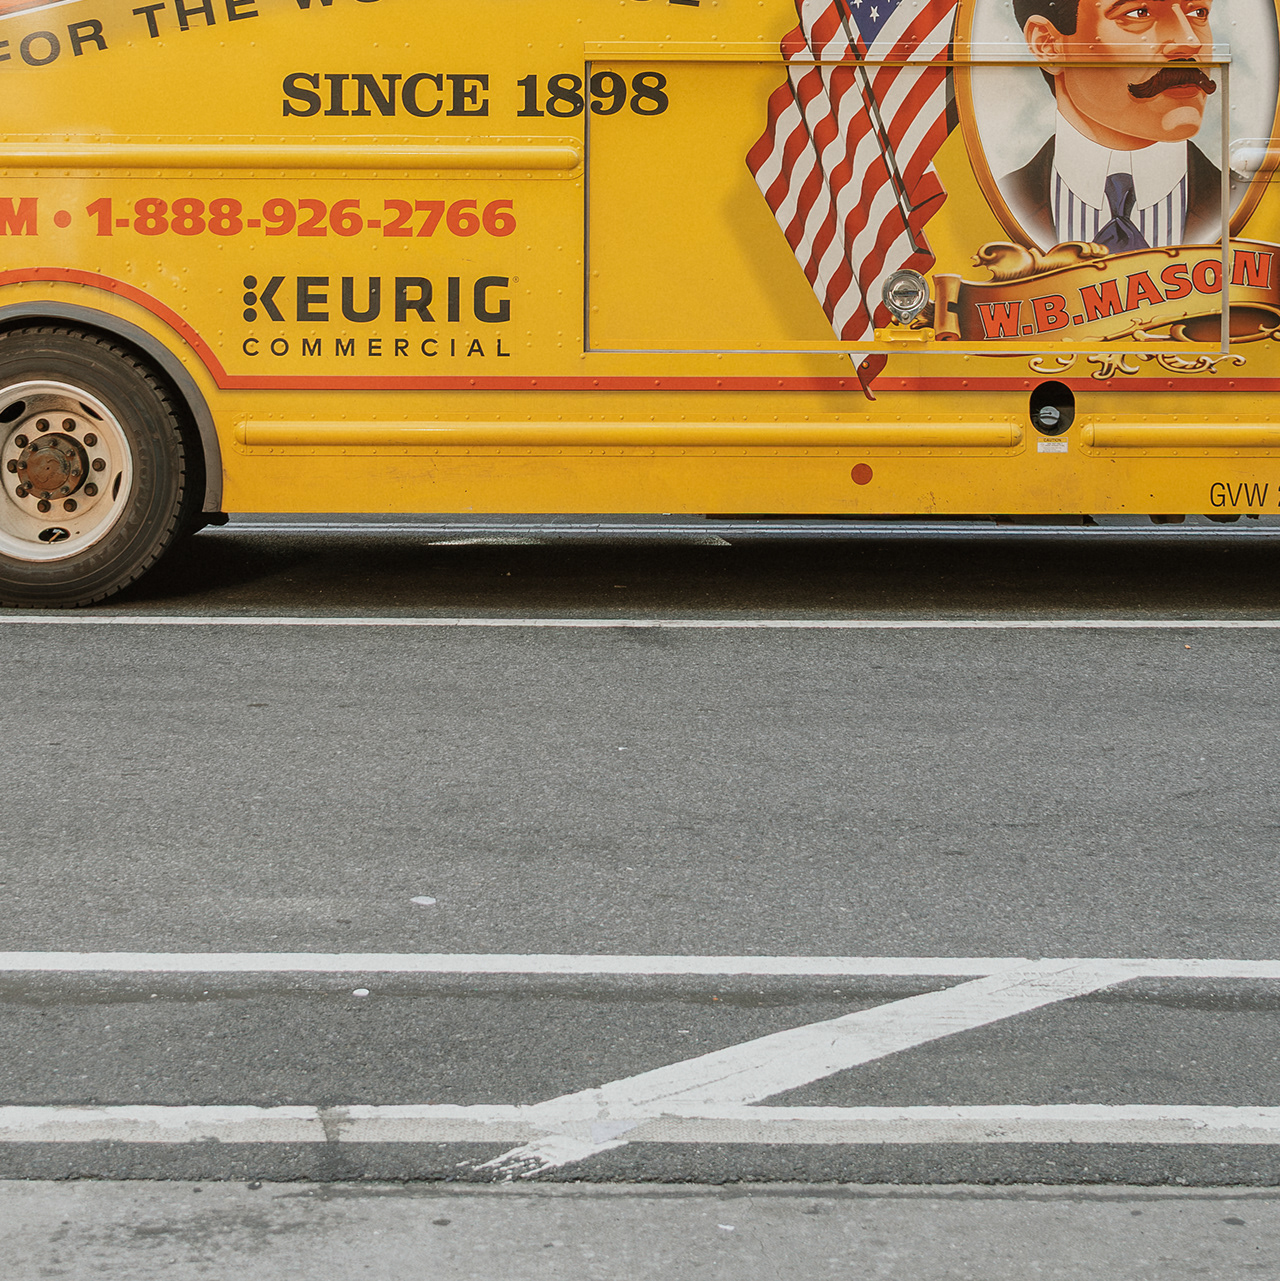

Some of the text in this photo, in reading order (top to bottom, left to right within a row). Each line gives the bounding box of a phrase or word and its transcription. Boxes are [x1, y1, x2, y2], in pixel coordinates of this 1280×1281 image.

[282, 71, 669, 118] SINCE 1898
[86, 197, 517, 237] 1-888-926-2766
[242, 337, 512, 358] COMMERCIAL
[1210, 482, 1269, 507] GVW
